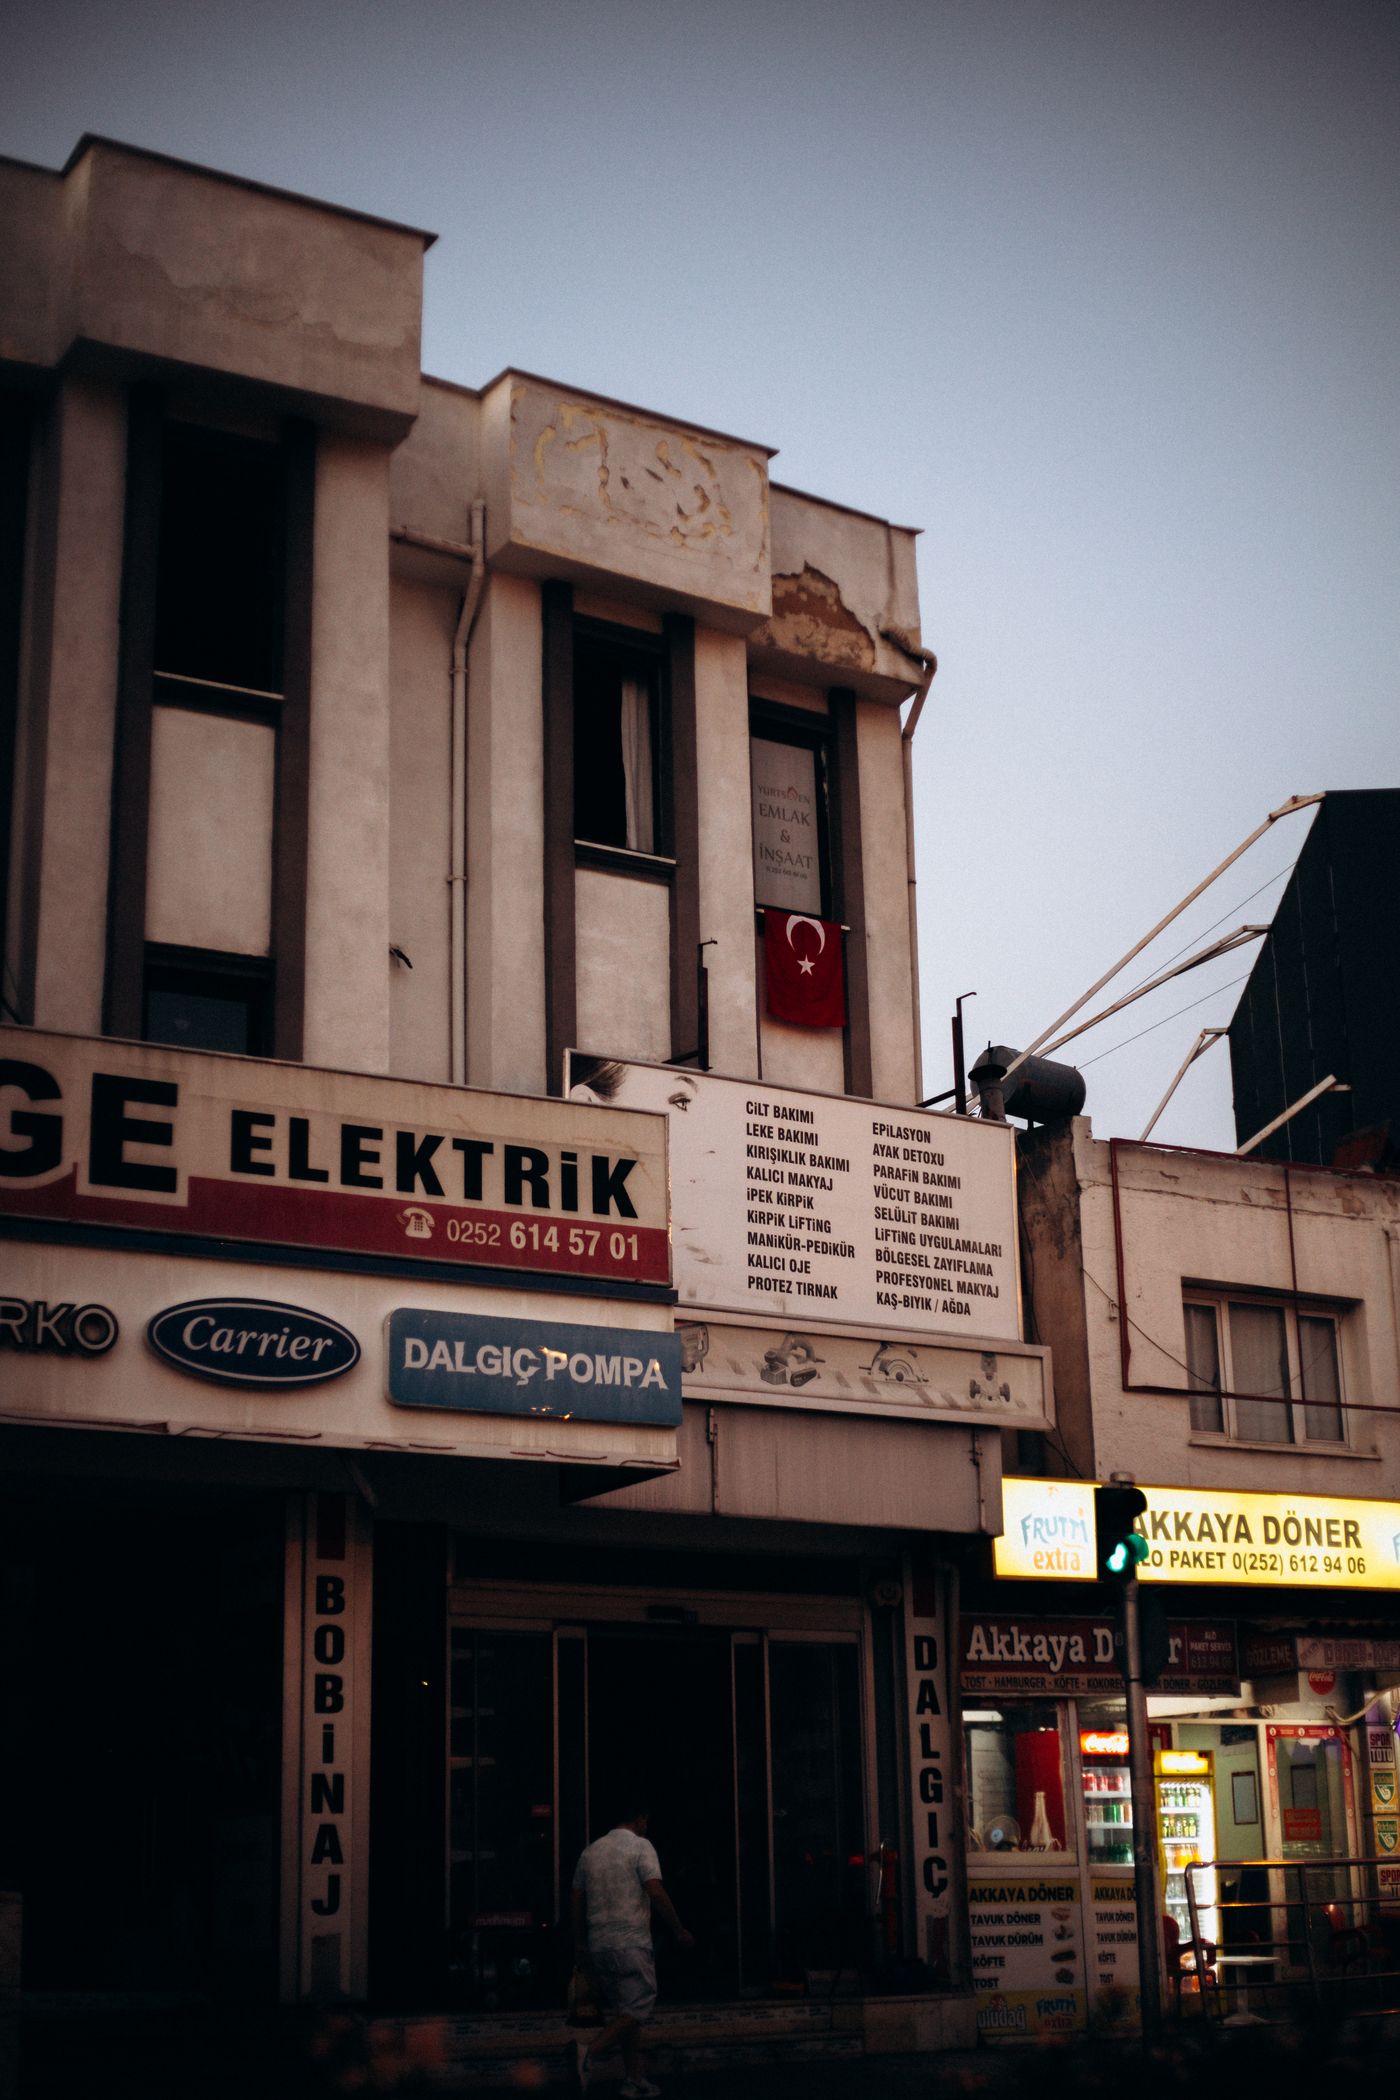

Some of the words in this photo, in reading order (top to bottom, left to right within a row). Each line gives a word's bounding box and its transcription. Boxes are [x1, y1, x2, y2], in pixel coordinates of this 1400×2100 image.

[759, 803, 810, 827] EMLAK
[780, 829, 791, 844] &
[773, 1105, 814, 1125] BAKIMI
[746, 1122, 774, 1139] LEKE
[777, 1127, 819, 1146] BAKIMI
[746, 1144, 806, 1166] KIRIŞIKLIK
[809, 1154, 850, 1173] BAKIMI
[872, 1143, 899, 1160] AYAK
[902, 1148, 945, 1167] DETOXU
[746, 1166, 784, 1184] KALICI
[788, 1172, 833, 1192] MAKYAJ
[922, 1171, 962, 1190] BAKIMI
[873, 1185, 910, 1203] VÜCUT
[914, 1191, 953, 1209] BAKIMI
[921, 1213, 960, 1230] BAKIMI
[446, 1219, 501, 1247] 0252
[509, 1221, 560, 1252] 614
[568, 1228, 601, 1257] 57
[609, 1231, 639, 1261] 01
[919, 1233, 1002, 1258] UYGULAMALARI
[747, 1253, 785, 1271] KALICI
[789, 1259, 811, 1275] OJE
[875, 1248, 930, 1269] BÖLGESEL
[933, 1256, 993, 1277] ZAYIFLAMA
[747, 1275, 793, 1294] PROTEZ
[796, 1281, 838, 1300] TIRNAK
[876, 1270, 953, 1293] PROFESYONEL
[956, 1280, 999, 1299] MAKYAJ
[876, 1291, 932, 1313] KAŞ-BIYIK
[941, 1297, 971, 1316] AĞDA
[182, 1314, 334, 1364] Carrier
[402, 1337, 541, 1386] DALGIÇ
[544, 1347, 669, 1391] POMPA
[1262, 1510, 1362, 1548] DÖNER
[1033, 1546, 1081, 1571] extra
[1170, 1550, 1226, 1570] PAKET
[1232, 1552, 1284, 1576] 0(252)
[1289, 1554, 1318, 1573] 612
[1323, 1555, 1342, 1574] 94
[1347, 1556, 1366, 1575] 06
[965, 1624, 1087, 1673] Akkaya
[965, 1676, 986, 1689] TOST
[994, 1677, 1046, 1689] HAMBURGER
[1053, 1675, 1080, 1690] KÖFTE
[1370, 1733, 1392, 1746] SPOR
[913, 1635, 948, 1899] DALGIÇ
[969, 1887, 1025, 1903] AKKAYA
[1028, 1883, 1074, 1902] DÖNER
[1094, 1887, 1126, 1901] AKKAYA
[971, 1914, 1004, 1925] TAVUK
[1006, 1911, 1041, 1924] DÖNER
[1095, 1912, 1114, 1922] TAVUK
[971, 1935, 1005, 1946] TAVUK
[1007, 1932, 1043, 1946] DÜRÜM
[1096, 1932, 1116, 1943] TAVUK
[973, 1953, 1005, 1968] KÖFTE
[974, 1977, 999, 1989] TOST
